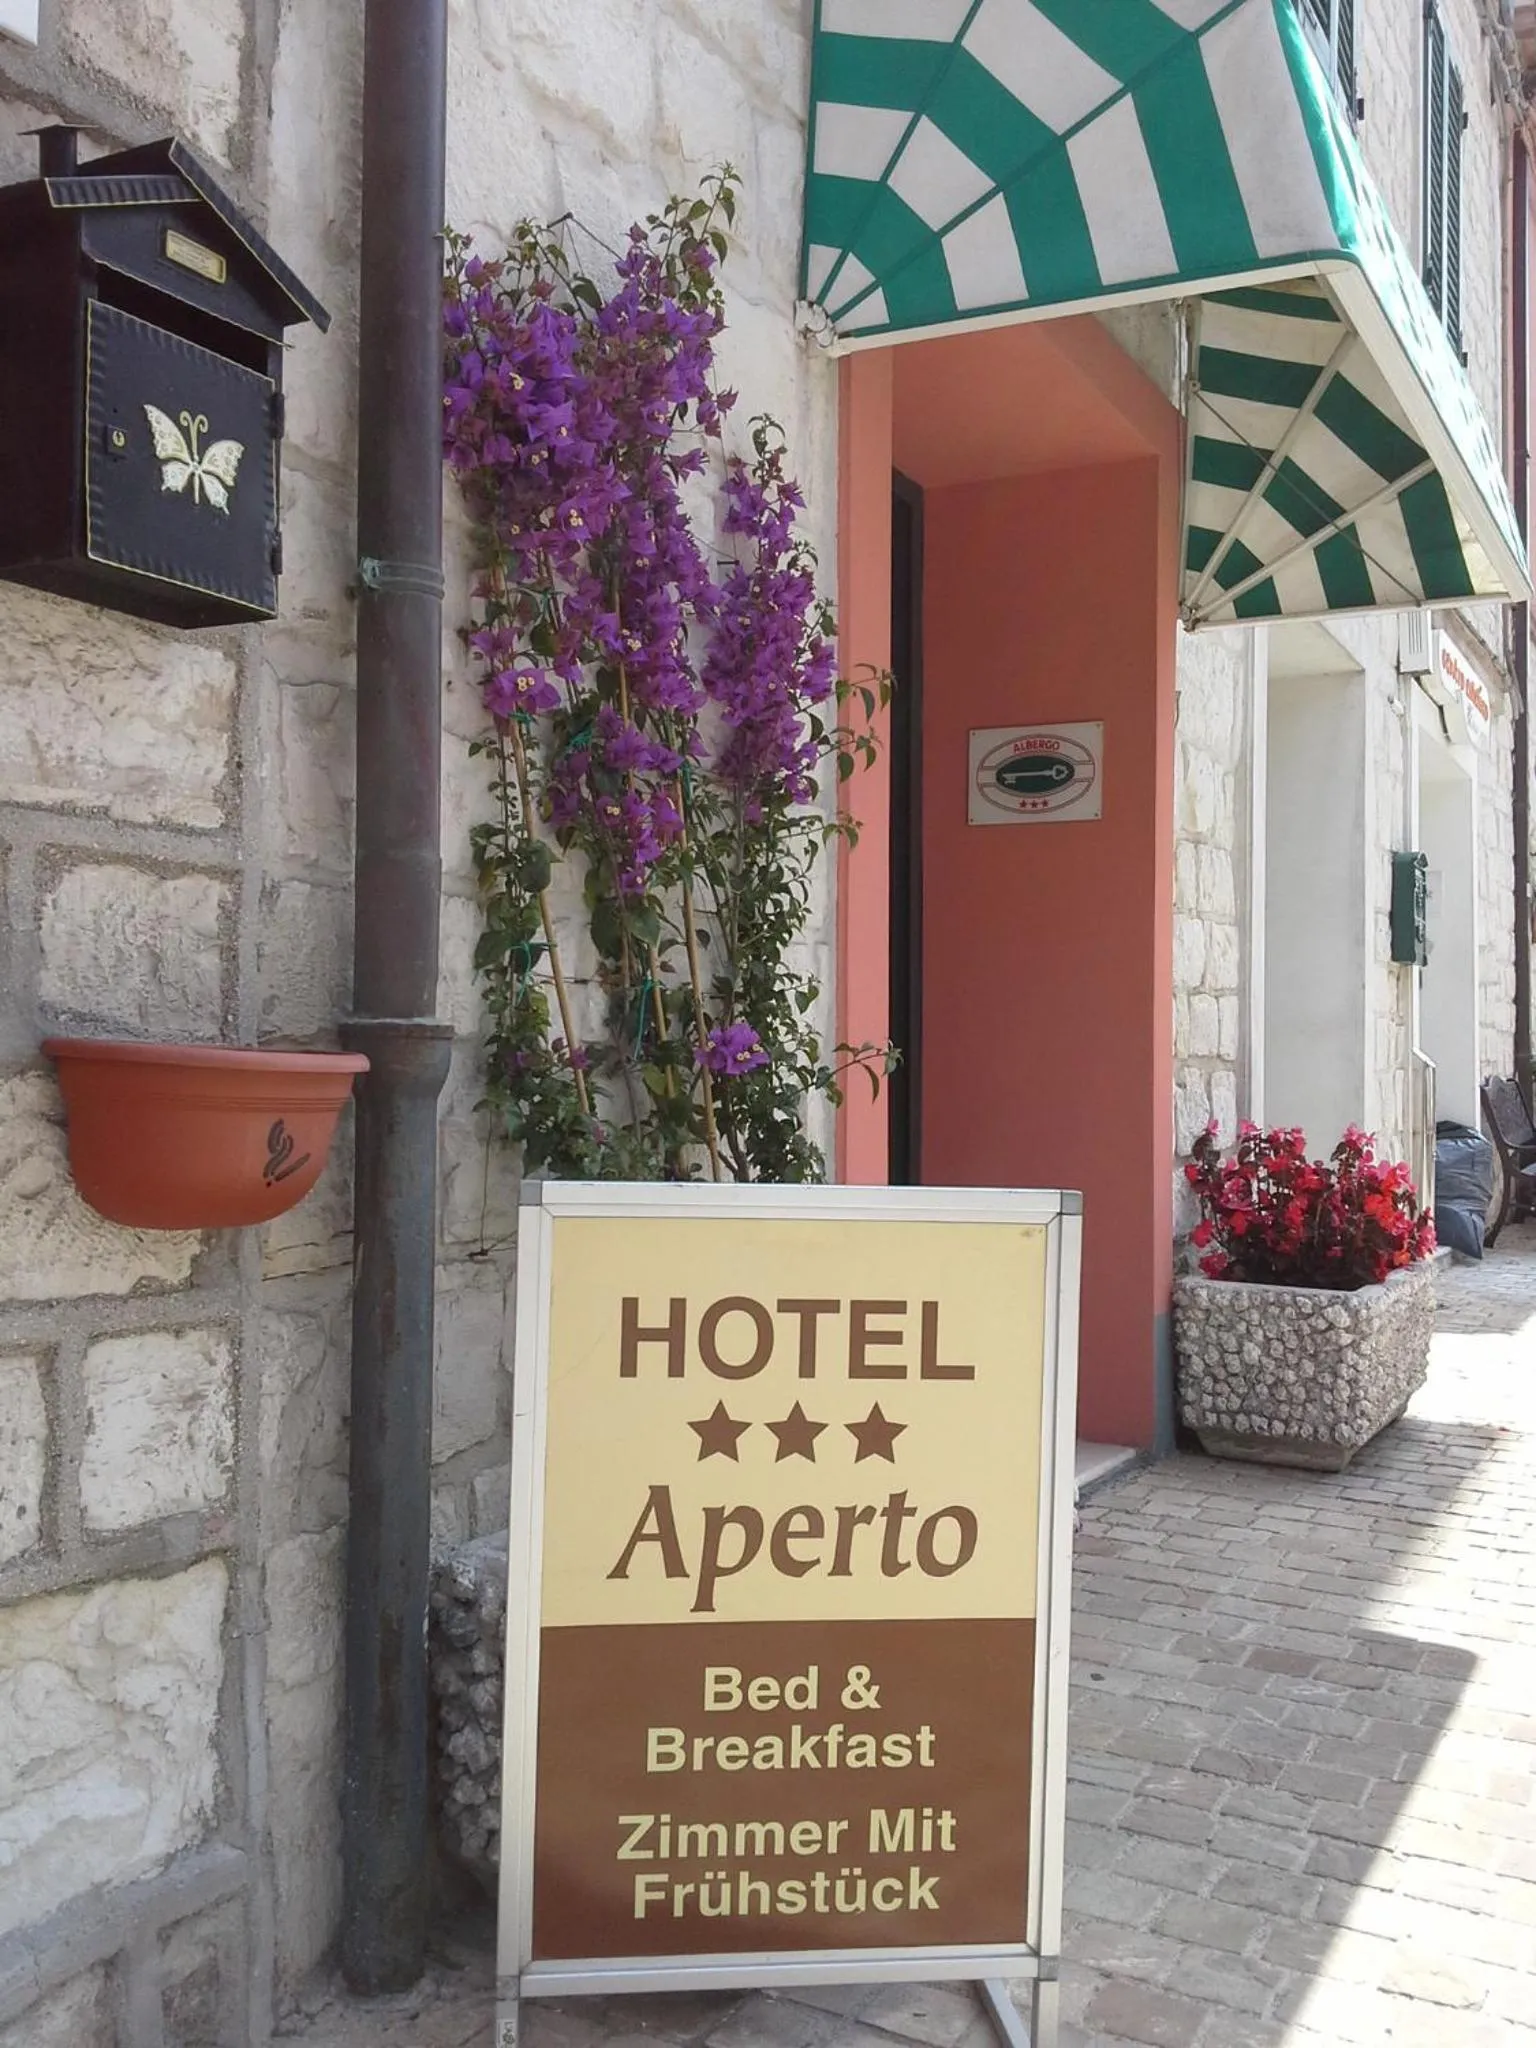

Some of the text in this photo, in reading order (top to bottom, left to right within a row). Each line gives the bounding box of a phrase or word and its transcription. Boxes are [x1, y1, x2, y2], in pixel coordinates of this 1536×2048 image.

[1013, 739, 1061, 753] ALBERGO
[620, 1296, 975, 1380] HOTEL
[606, 1484, 977, 1613] Aperto
[705, 1666, 881, 1710] Bed &
[647, 1724, 935, 1771] Breakfast
[618, 1808, 956, 1859] Zimmer Mit
[635, 1867, 939, 1917] Frühstück
